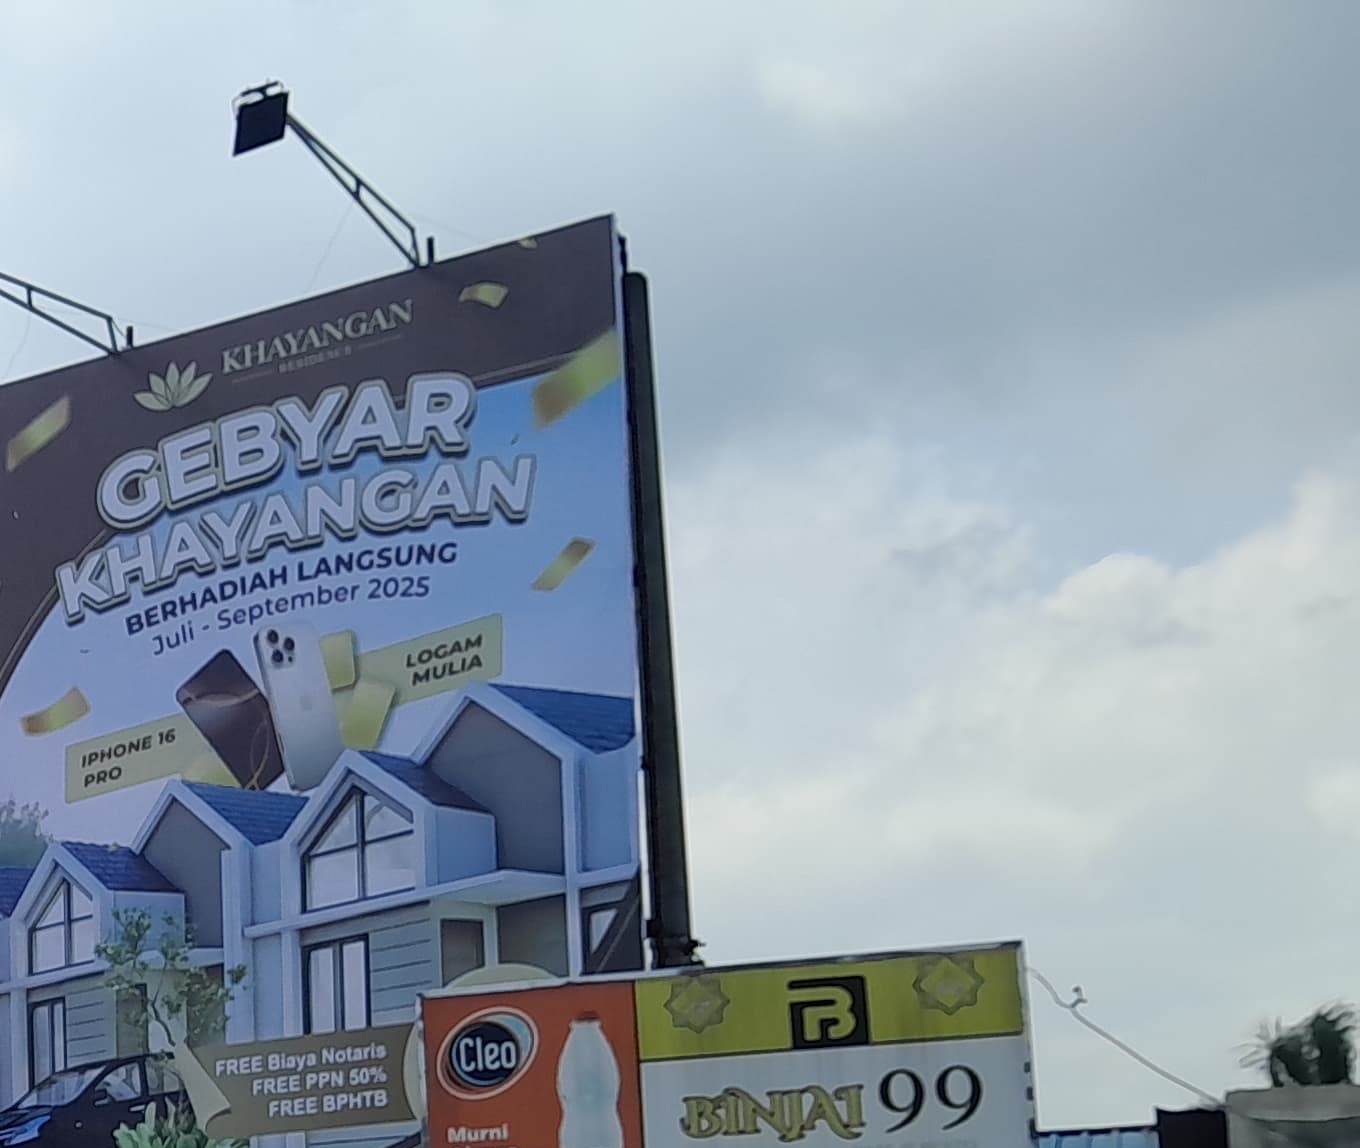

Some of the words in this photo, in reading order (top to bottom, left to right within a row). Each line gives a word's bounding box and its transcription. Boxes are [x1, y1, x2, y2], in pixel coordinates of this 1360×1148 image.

[221, 300, 414, 375] KHAYANGAN
[98, 373, 478, 528] GEBYAR
[56, 457, 536, 624] KHAYANGAN
[125, 567, 289, 636] BERHADIAH
[298, 542, 458, 580] LANGSUNG
[152, 622, 195, 656] Juli
[217, 583, 360, 632] September
[367, 576, 431, 600] 2025
[405, 633, 483, 668] LOGAM
[412, 655, 483, 687] MULIA
[81, 736, 152, 768] IPHONE
[158, 728, 177, 745] 16
[84, 766, 122, 788] PRO
[215, 1056, 263, 1077] FREE
[268, 1052, 316, 1072] Biaya
[321, 1043, 387, 1065] Notaris
[459, 1037, 517, 1073] Cleo
[252, 1079, 300, 1096] FREE
[305, 1071, 344, 1090] PPN
[349, 1067, 387, 1085] 50%
[269, 1099, 319, 1117] FREE
[323, 1089, 388, 1113] BPHTB
[681, 1084, 867, 1142] BINJAI
[879, 1064, 985, 1134] 99
[447, 1124, 509, 1143] Murni
